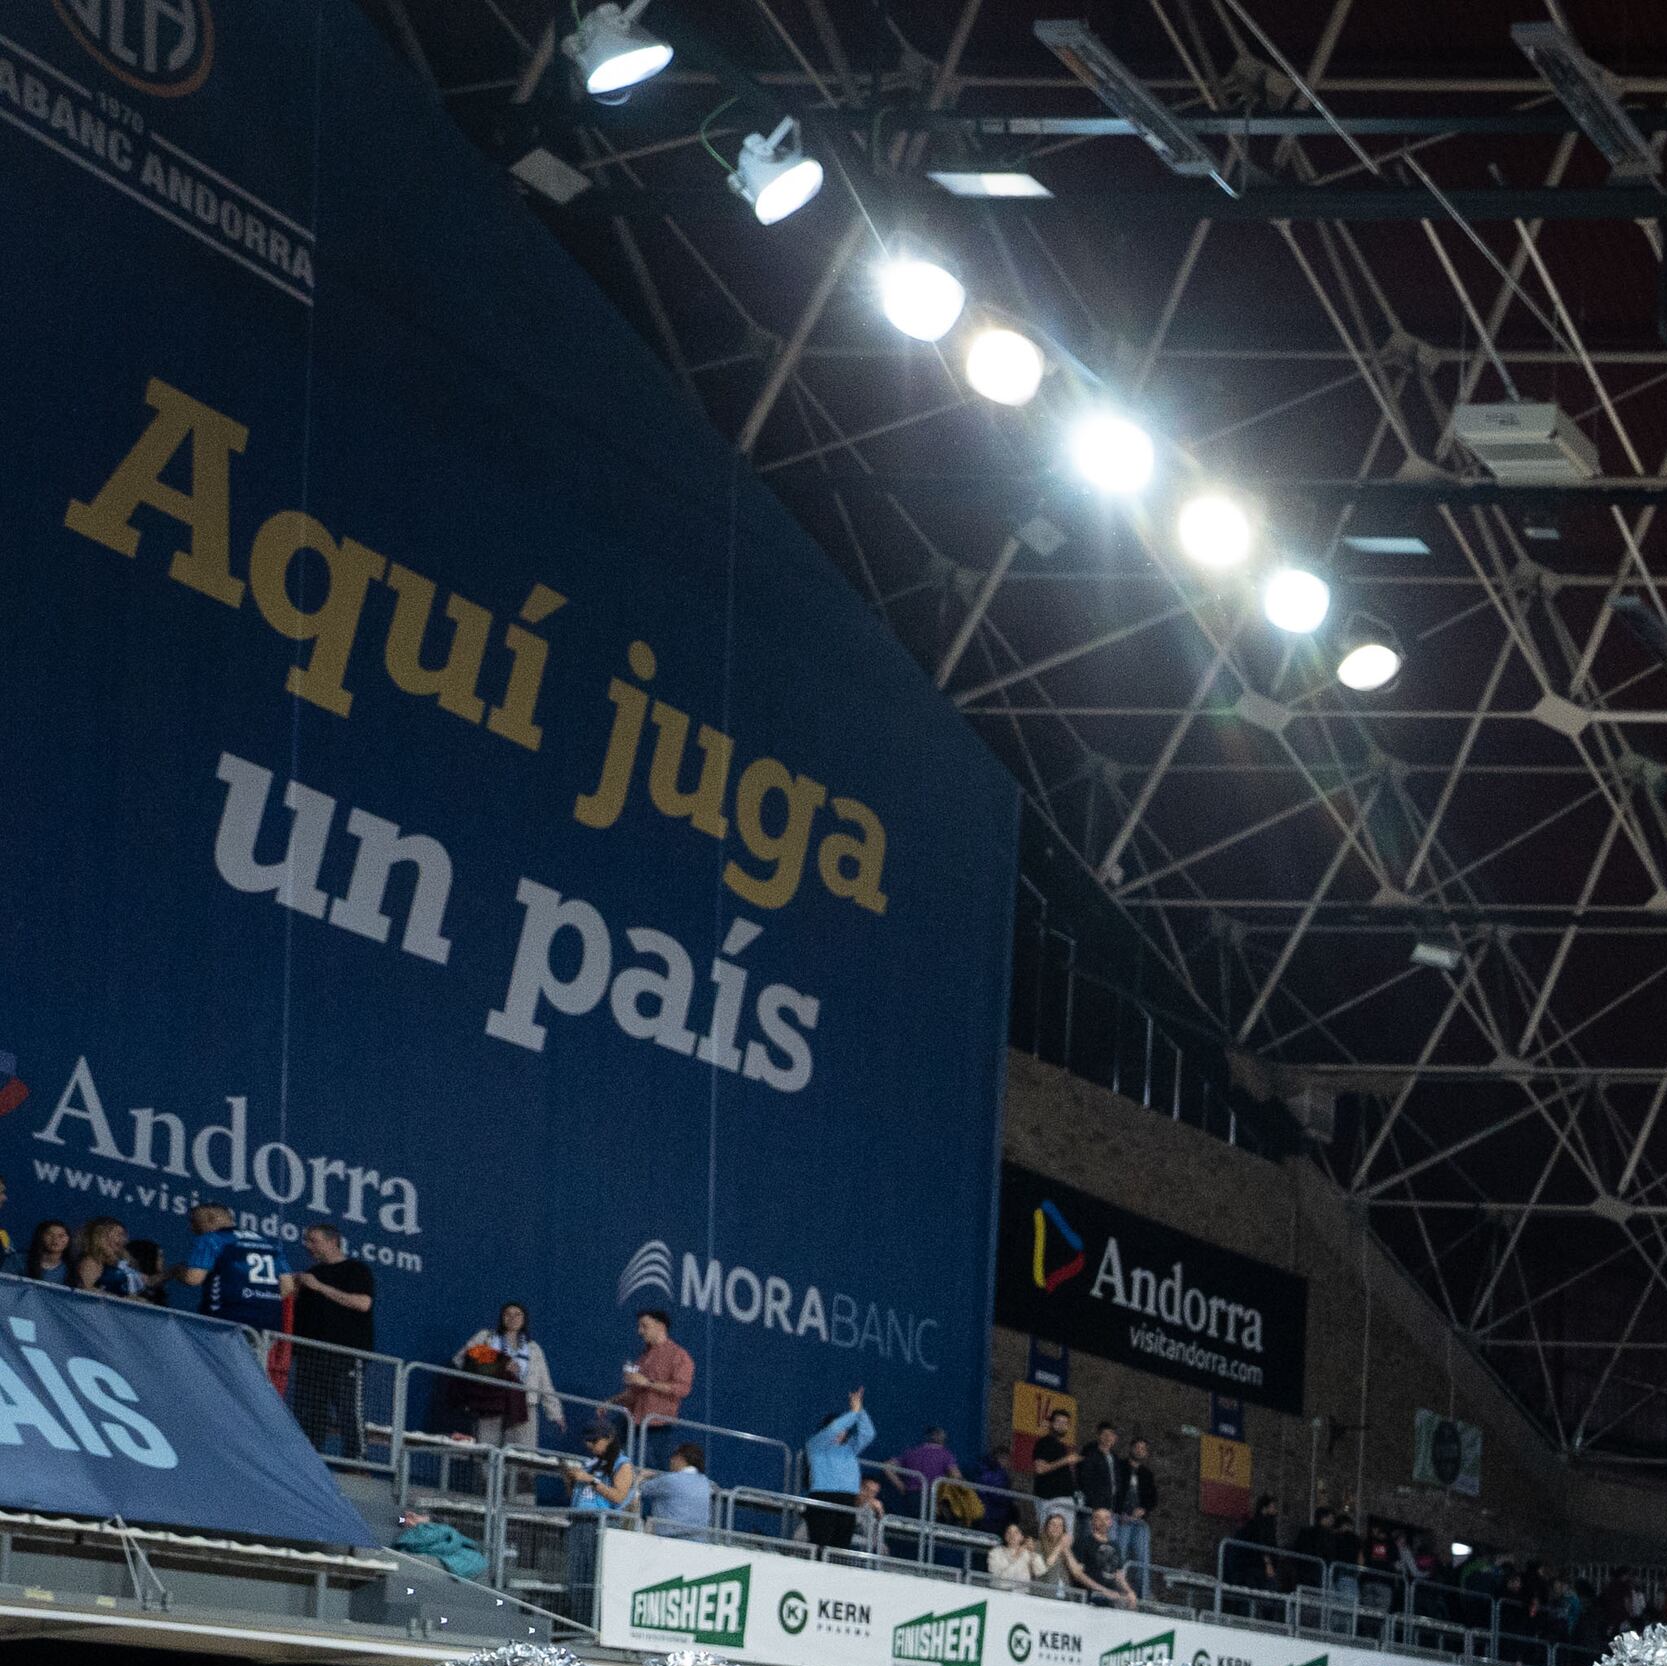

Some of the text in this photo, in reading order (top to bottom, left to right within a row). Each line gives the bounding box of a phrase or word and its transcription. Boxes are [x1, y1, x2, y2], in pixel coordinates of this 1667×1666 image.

[140, 154, 314, 288] ANDORRA
[64, 375, 888, 915] Aquí juga
[213, 752, 820, 1093] un país
[32, 1055, 422, 1237] Andorra
[246, 1252, 279, 1285] 21
[680, 1251, 939, 1373] MORABANC
[1090, 1236, 1264, 1353] Andorra
[1129, 1324, 1264, 1386] visitandorra.com
[633, 1579, 741, 1633] FINISHER
[817, 1600, 872, 1624] KERN
[895, 1614, 980, 1663] FINISHER
[1038, 1630, 1082, 1653] KERN
